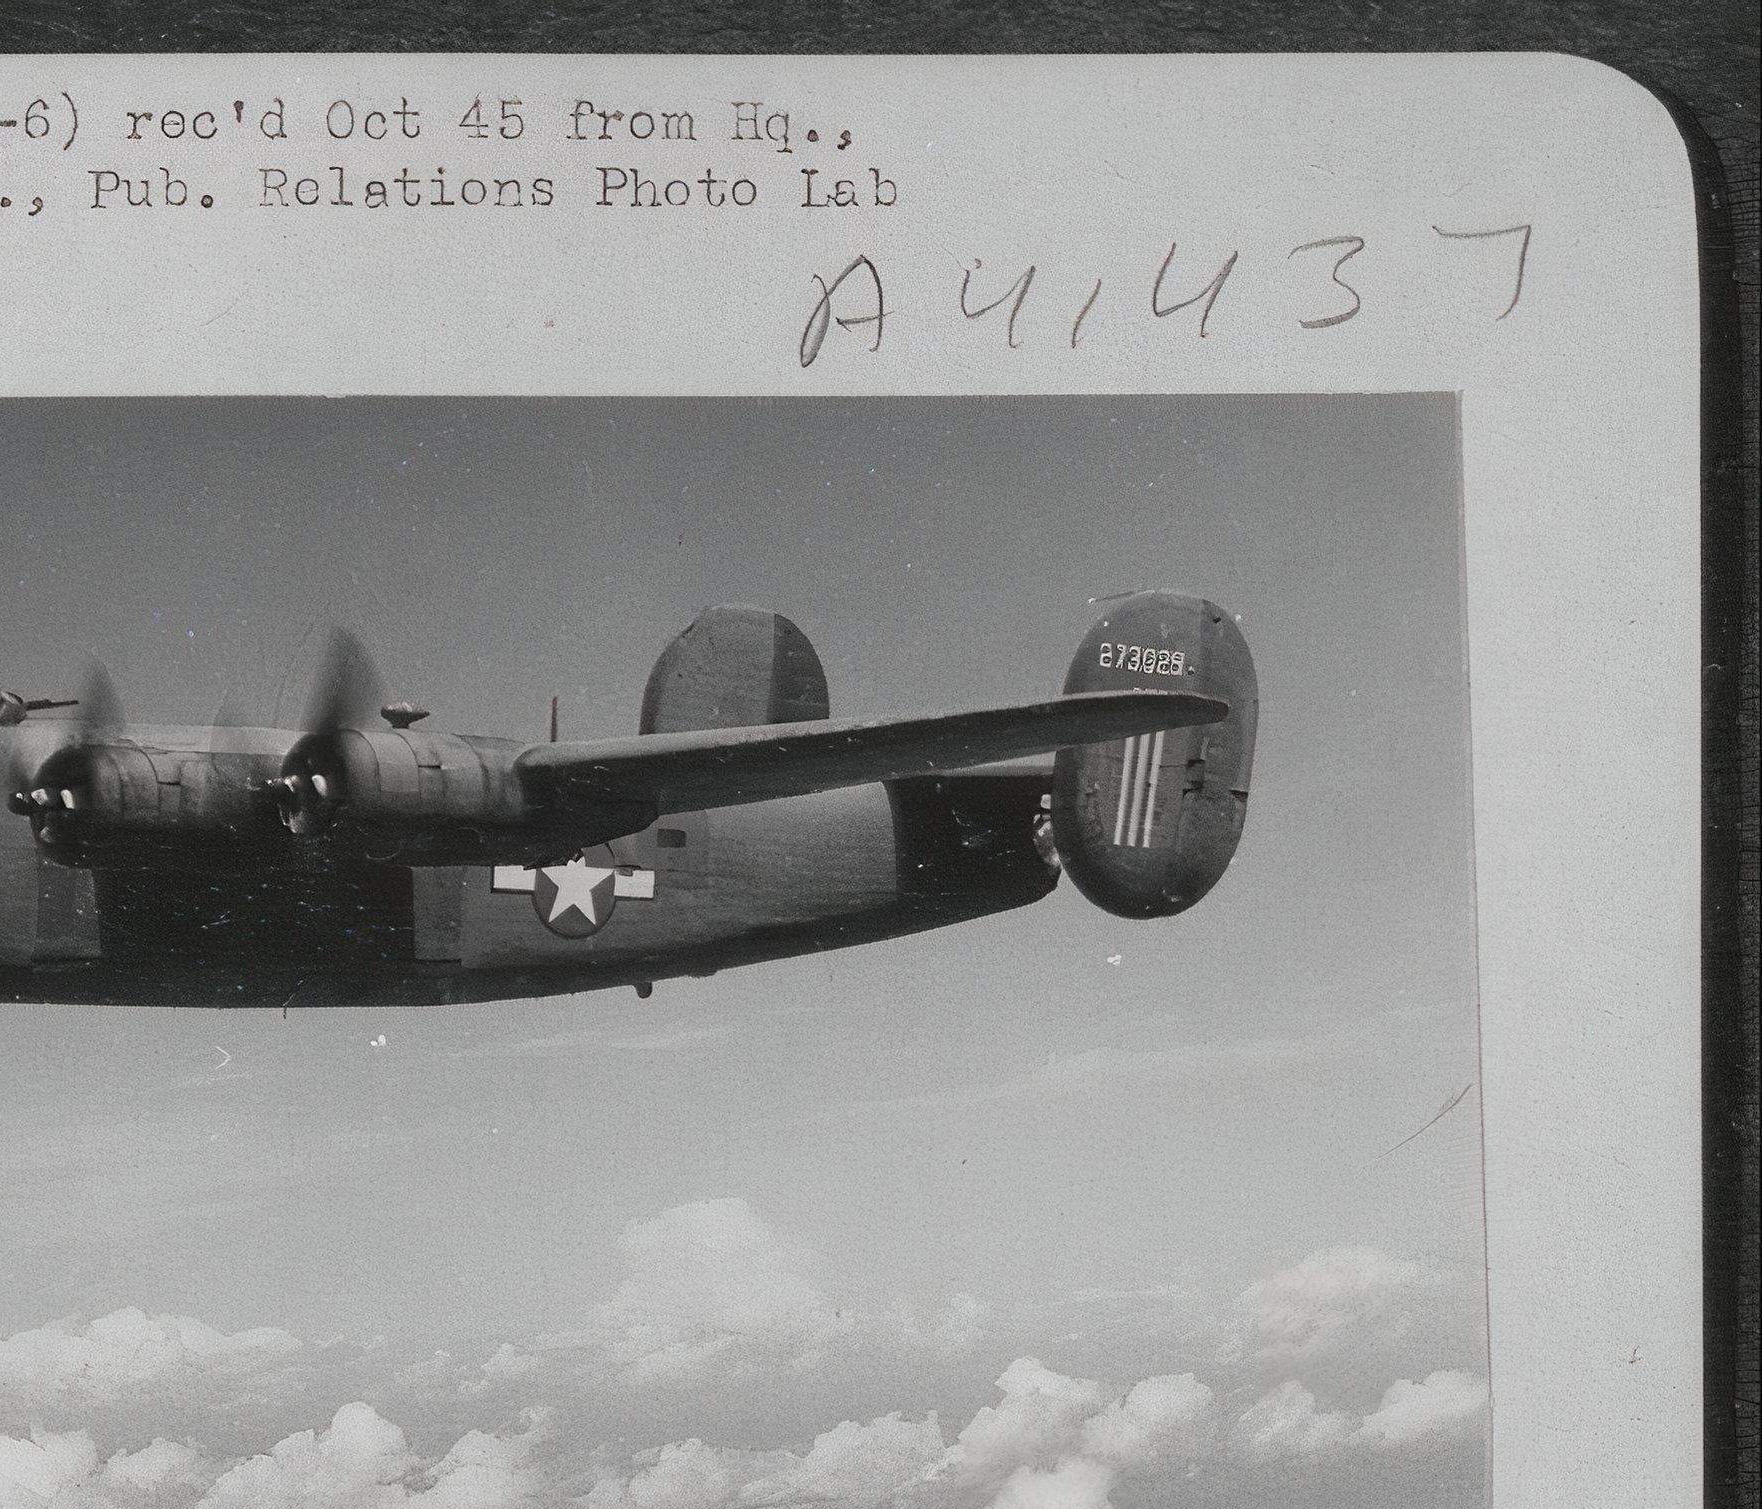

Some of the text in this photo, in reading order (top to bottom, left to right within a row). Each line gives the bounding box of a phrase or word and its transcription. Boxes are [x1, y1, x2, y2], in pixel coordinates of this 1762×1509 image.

[127, 97, 287, 142] rec'd
[326, 97, 422, 142] Oct
[459, 94, 525, 141] 45
[566, 99, 697, 142] from
[731, 102, 854, 154] Hq.,
[88, 167, 215, 210] Pub.
[259, 166, 555, 209] Relations
[596, 166, 758, 208] Photo
[800, 166, 898, 208] Lab
